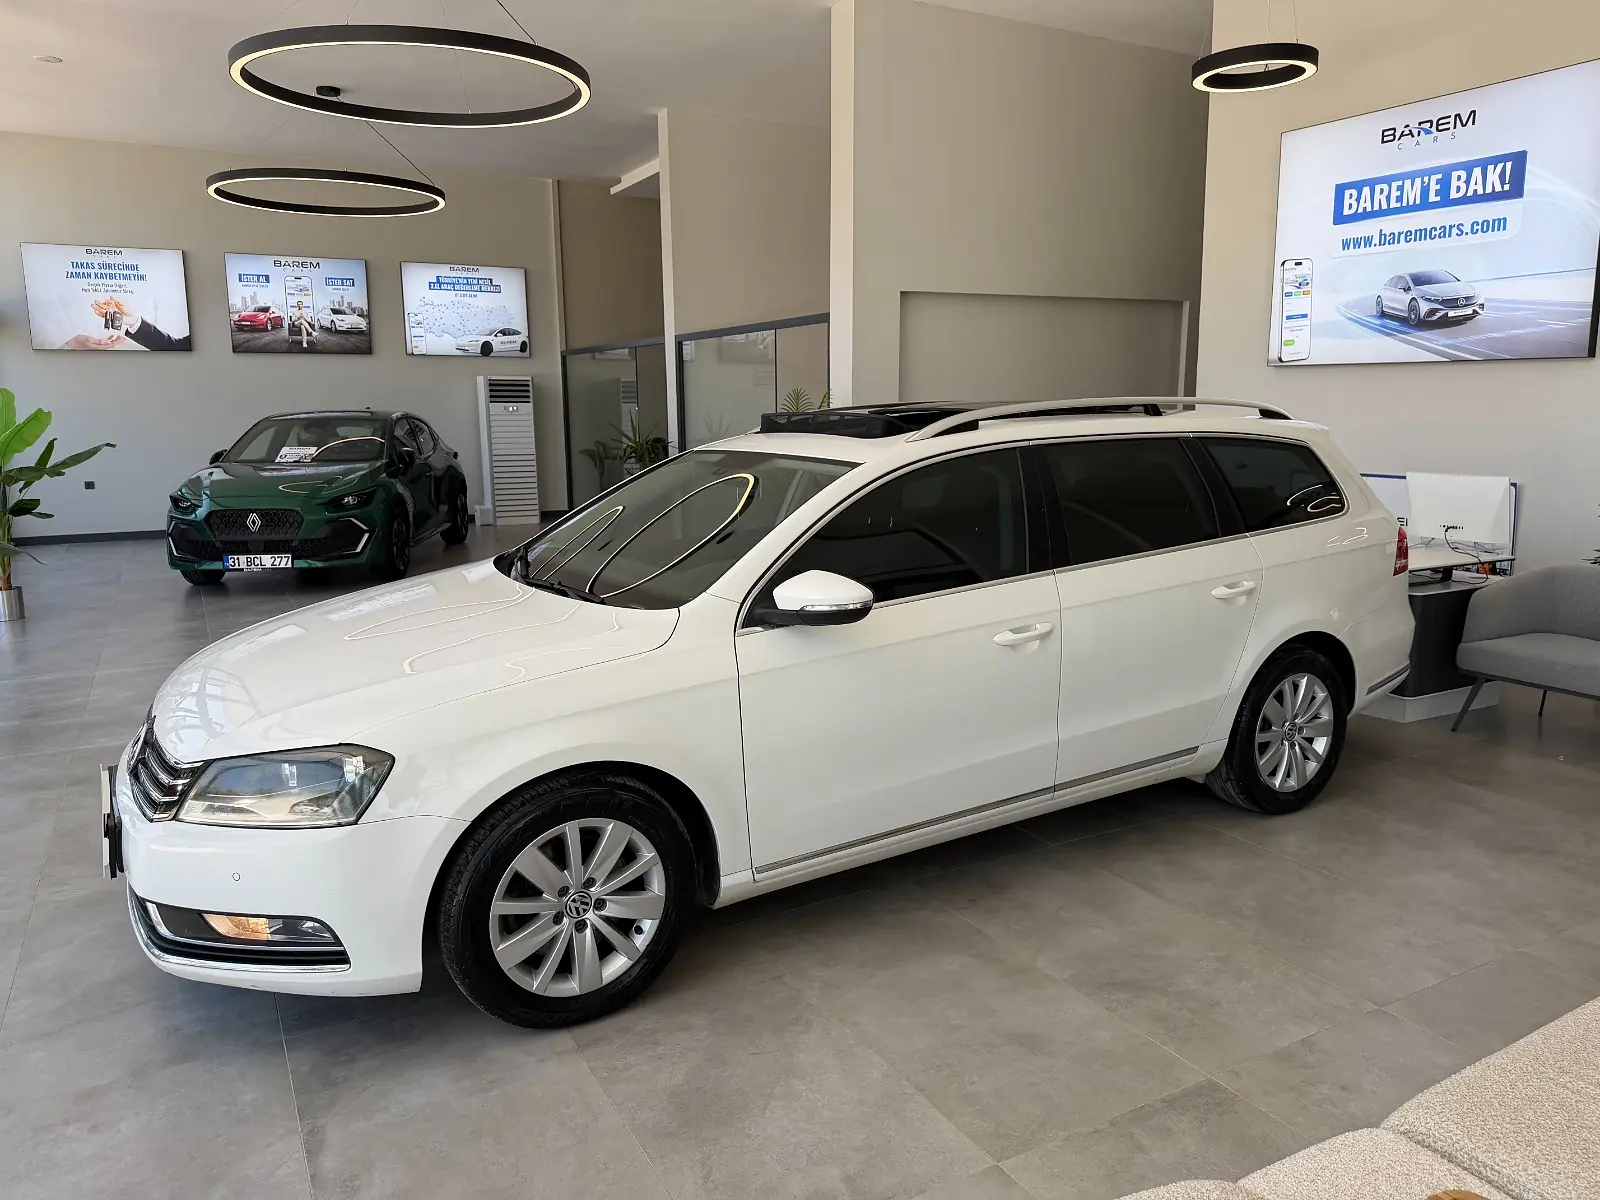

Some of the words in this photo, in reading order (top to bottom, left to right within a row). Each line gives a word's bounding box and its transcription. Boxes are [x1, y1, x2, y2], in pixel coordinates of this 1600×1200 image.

[1381, 109, 1477, 144] BAREM
[1397, 131, 1456, 150] CARS
[1343, 173, 1443, 216] BAREM'E
[1449, 160, 1513, 200] BAK!
[1341, 216, 1508, 251] www.baremcars.com
[86, 248, 123, 256] BAREM
[70, 261, 96, 270] TAKAS
[97, 261, 140, 272] SÜRECİNDE
[273, 260, 320, 269] BAREM
[65, 271, 92, 280] ZAMAN
[94, 271, 148, 282] KAYBETMEYİN!
[259, 275, 268, 283] AL
[343, 279, 354, 287] SAT
[229, 556, 241, 567] 31
[246, 556, 267, 567] BCL
[270, 556, 291, 567] 277
